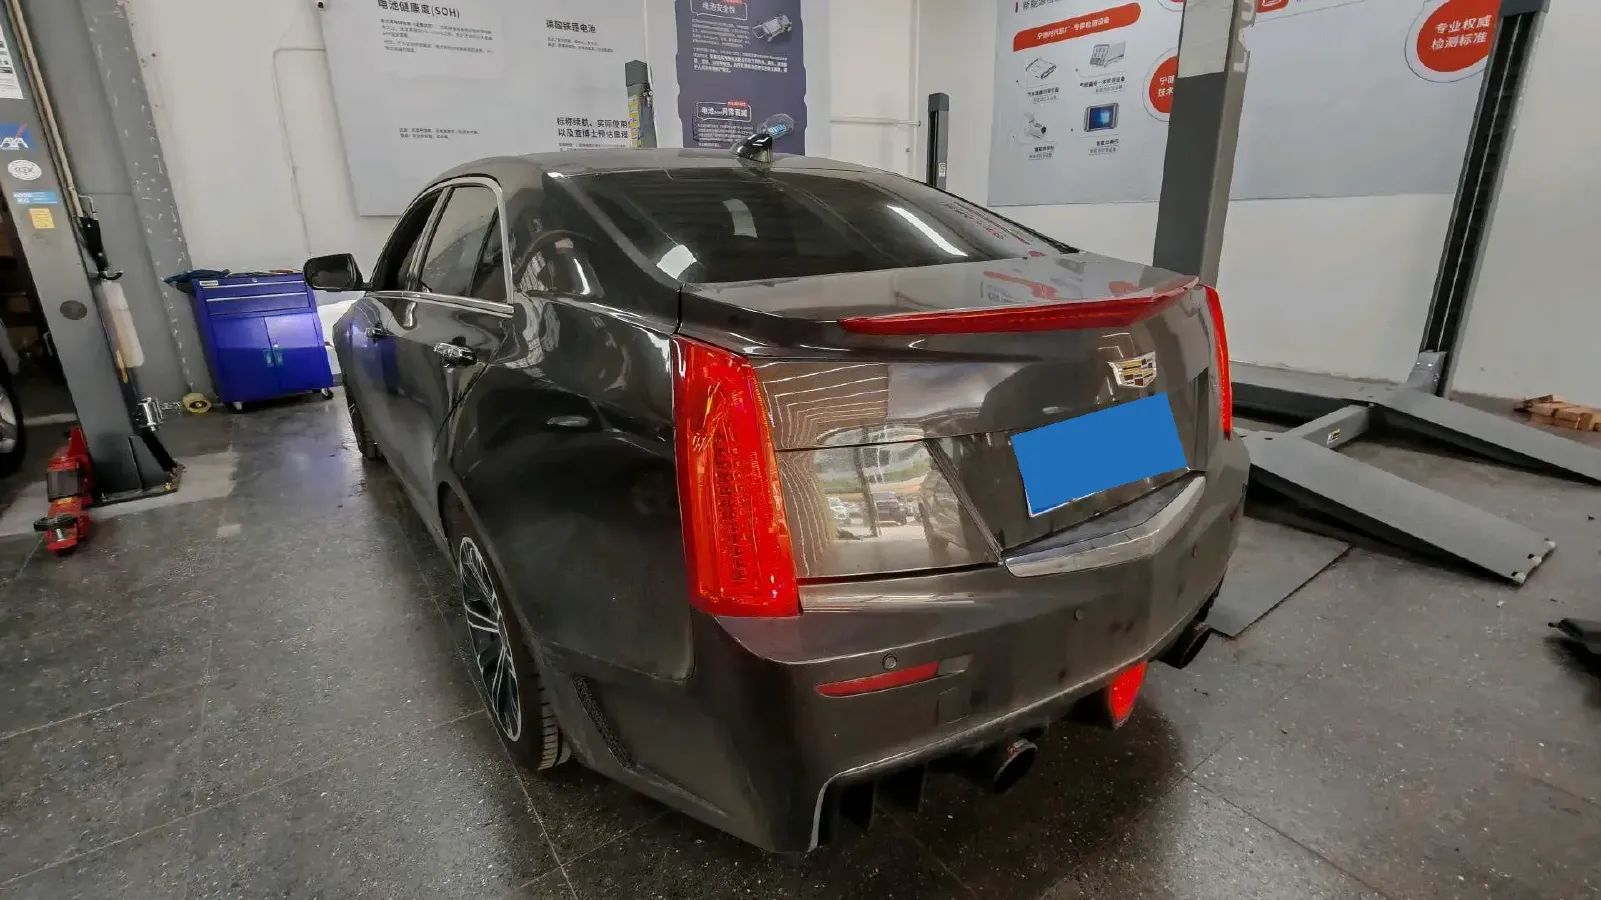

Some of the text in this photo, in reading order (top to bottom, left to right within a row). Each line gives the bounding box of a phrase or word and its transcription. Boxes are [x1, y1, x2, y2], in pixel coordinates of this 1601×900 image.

[378, 0, 460, 19] 电池健康度(SOH)
[546, 19, 597, 34] 磷酸铁锂电池
[1435, 15, 1491, 34] 专业权威
[1431, 32, 1487, 50] 检测标准
[557, 117, 630, 129] 标称续航、实际使用
[0, 137, 29, 149] AXA
